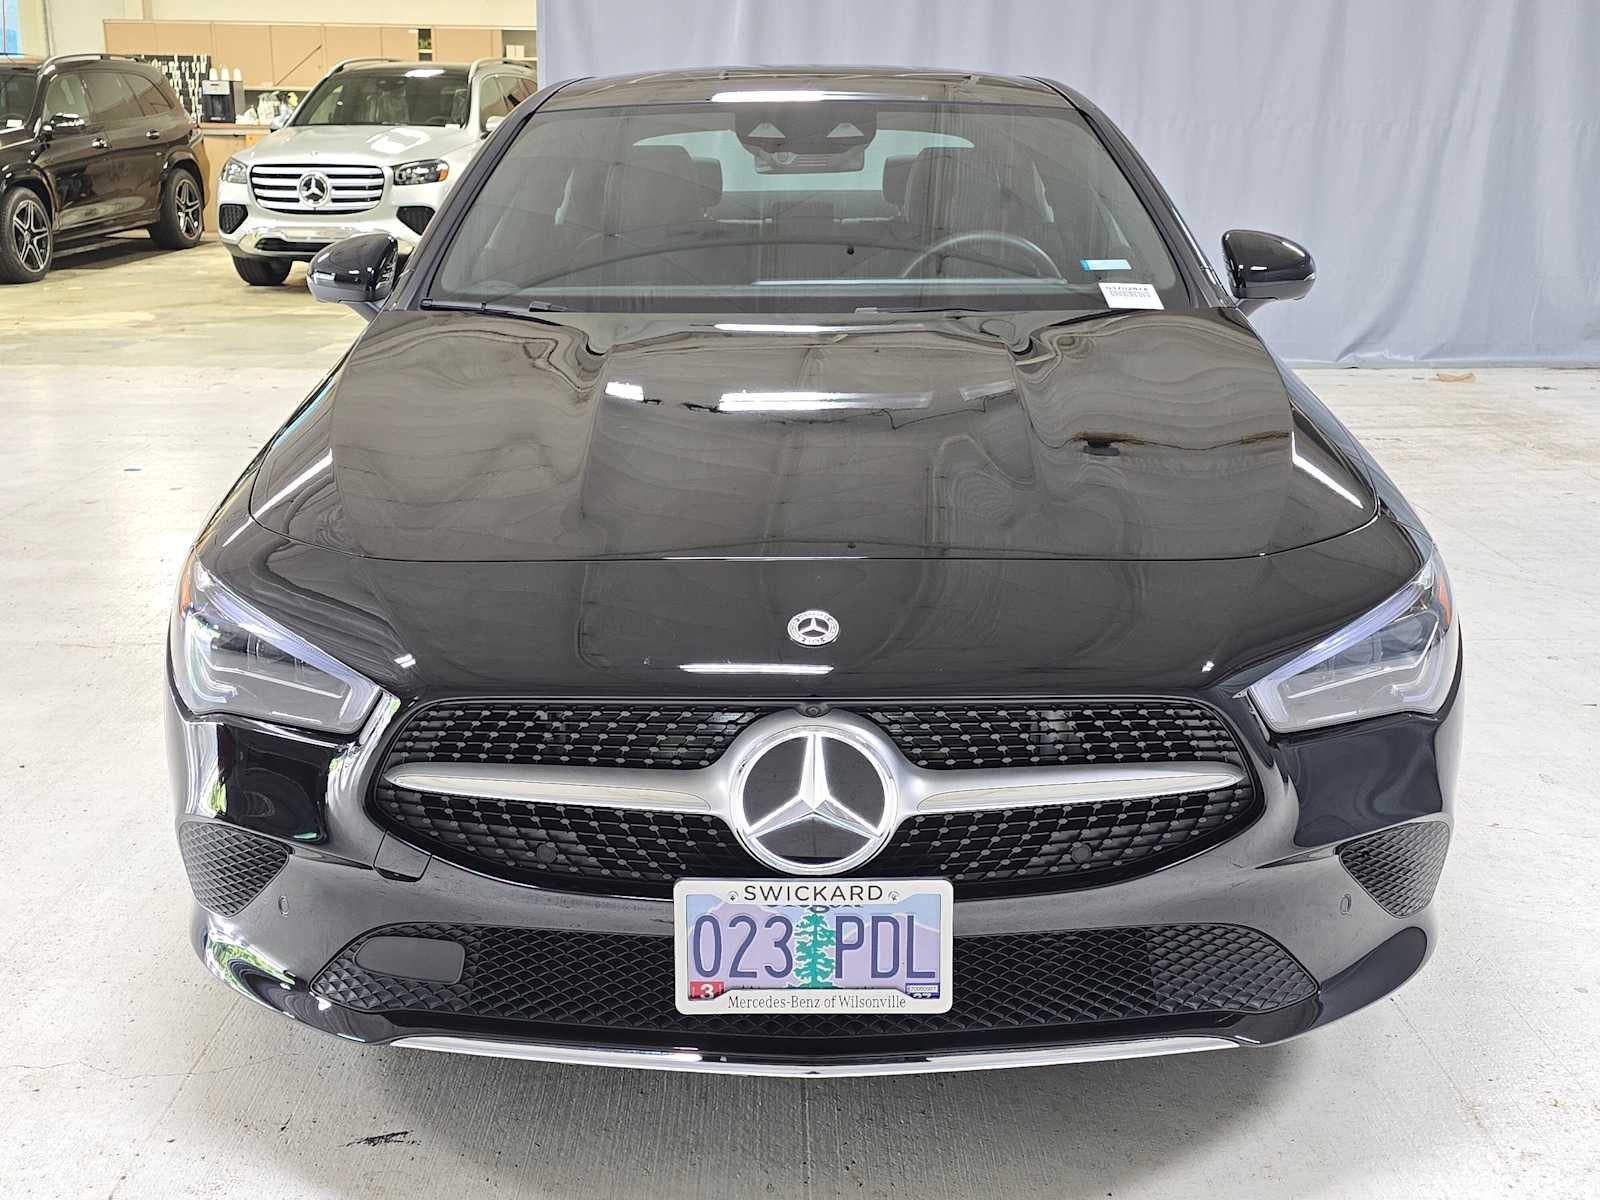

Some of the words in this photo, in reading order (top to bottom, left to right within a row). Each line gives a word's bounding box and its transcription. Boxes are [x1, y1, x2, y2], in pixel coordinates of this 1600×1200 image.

[743, 885, 884, 902] SWICKARD
[692, 914, 794, 979] 023
[835, 914, 936, 979] PDL
[728, 995, 821, 1009] Mercedes-Benz
[824, 995, 837, 1009] of
[838, 995, 906, 1009] Wilsonville
